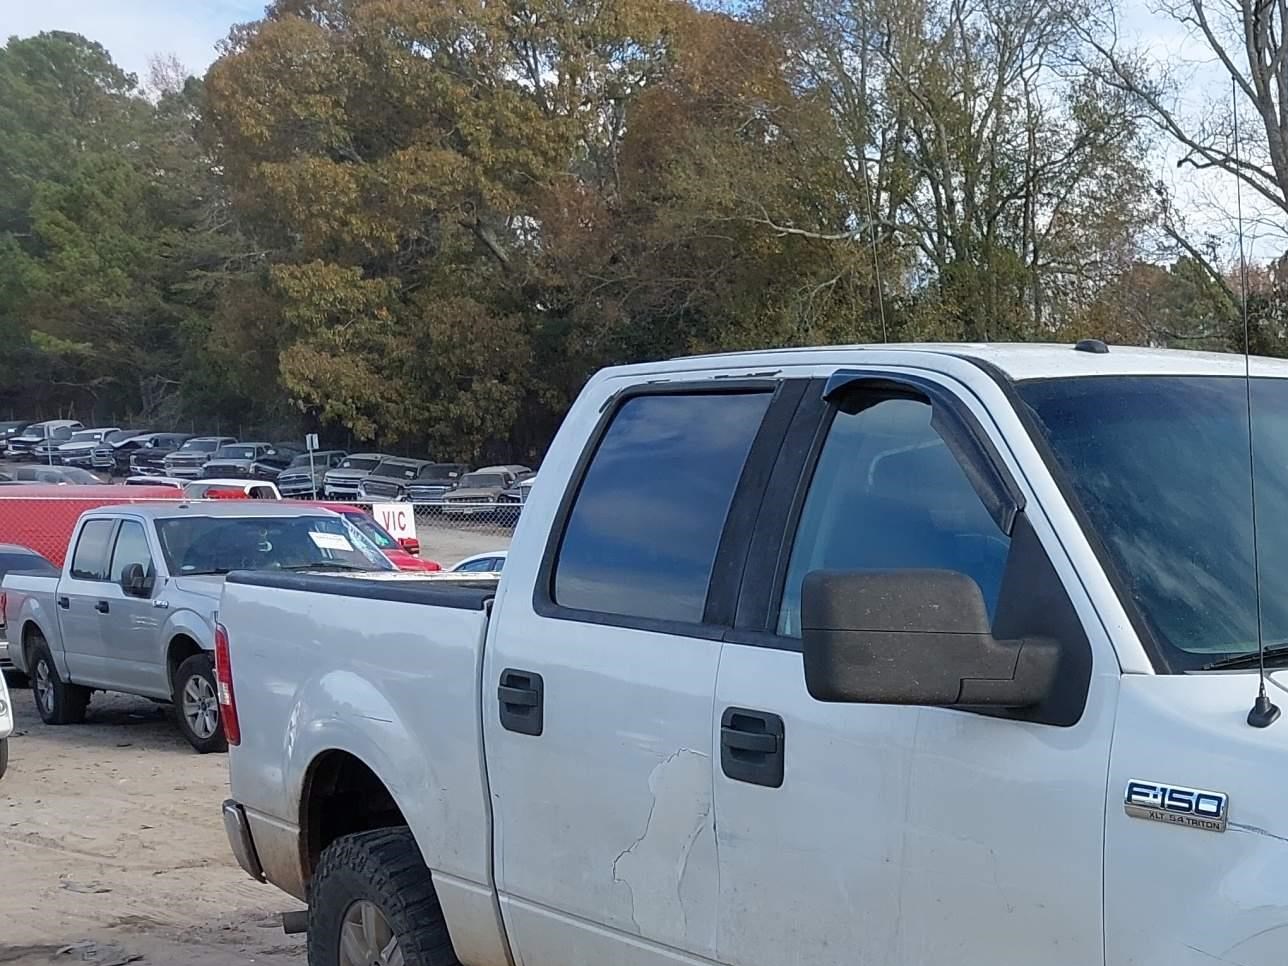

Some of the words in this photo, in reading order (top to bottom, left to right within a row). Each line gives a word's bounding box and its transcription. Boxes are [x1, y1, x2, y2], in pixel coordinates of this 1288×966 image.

[382, 510, 406, 531] VIC
[1126, 781, 1223, 818] F-150
[1186, 817, 1220, 830] TRITON
